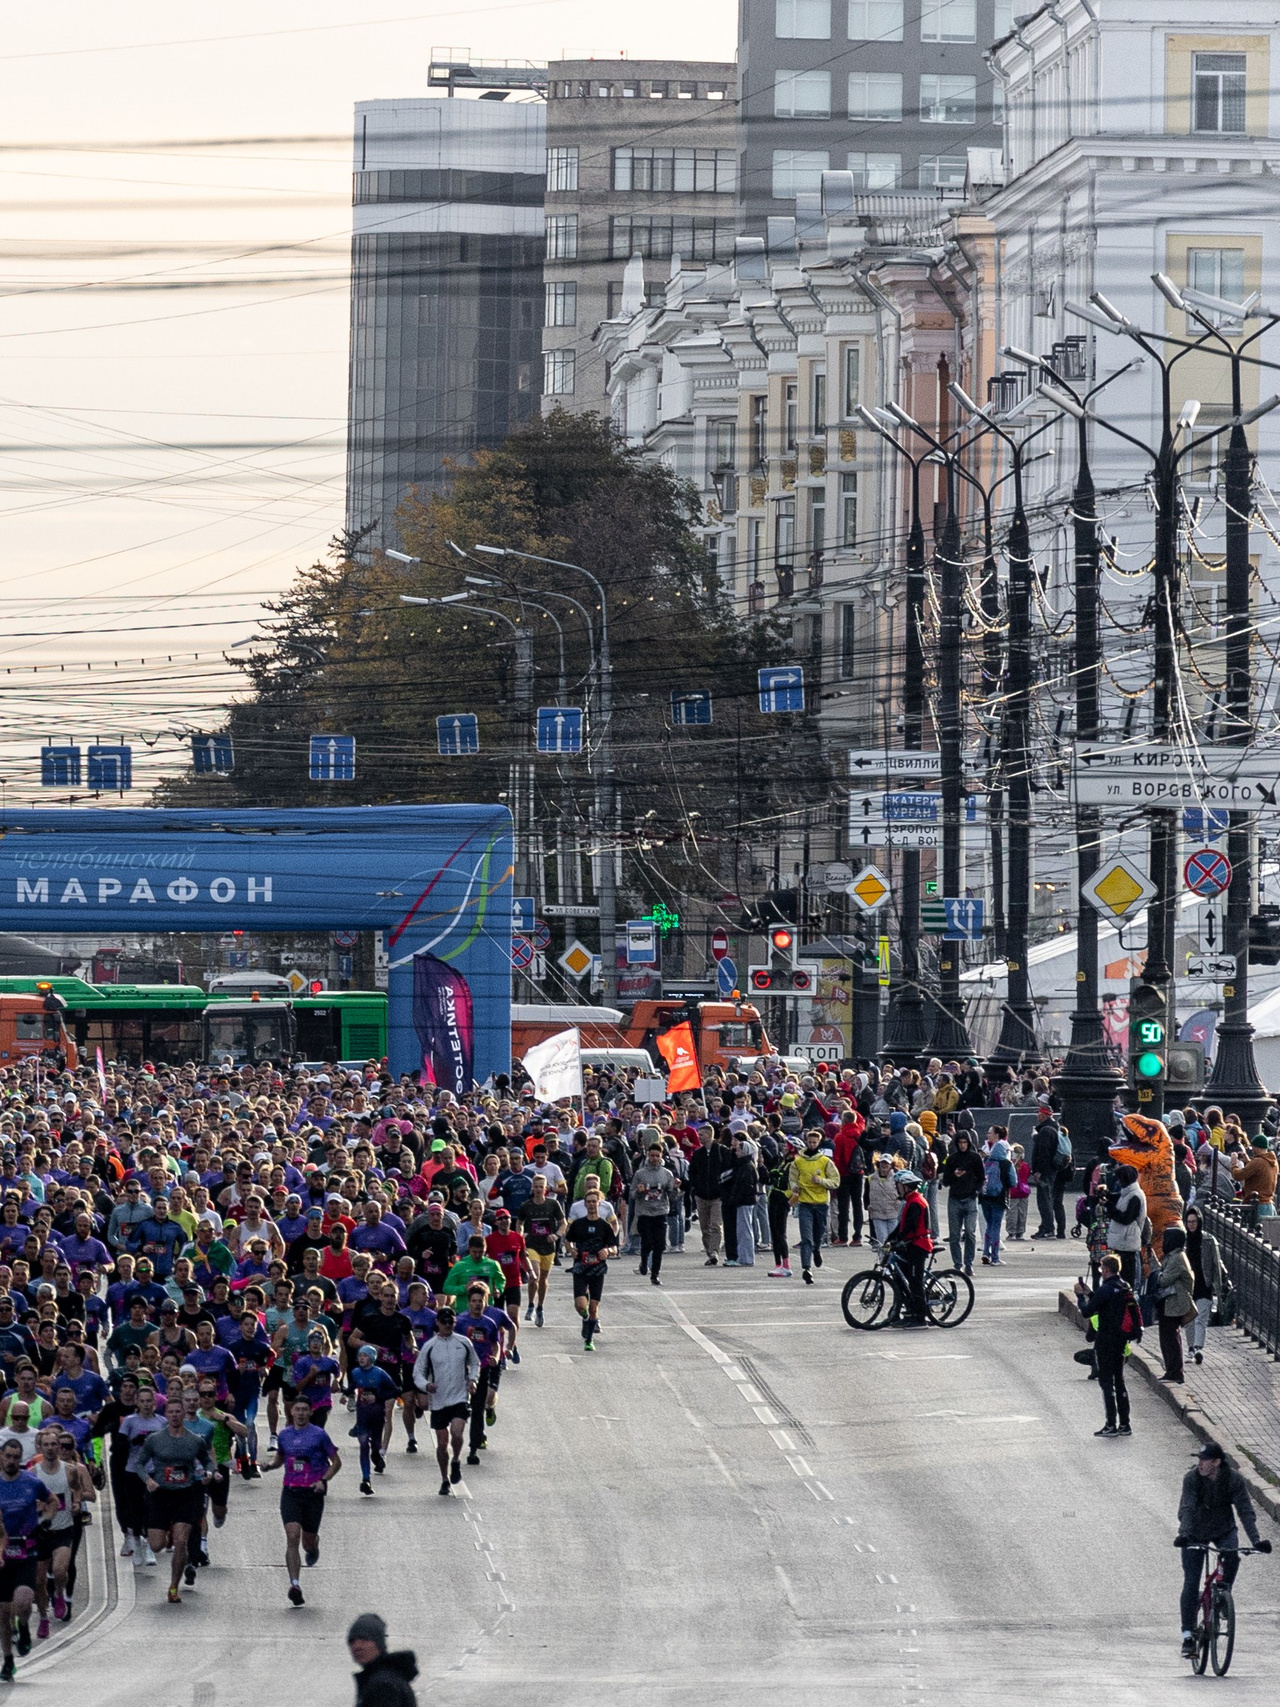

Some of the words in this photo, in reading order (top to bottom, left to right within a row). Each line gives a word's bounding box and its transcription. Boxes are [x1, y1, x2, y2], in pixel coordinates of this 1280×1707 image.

[889, 759, 939, 770] ЦВИЛЛИ
[1133, 752, 1208, 768] КИРОВА
[1132, 782, 1252, 800] ВОРОВСКОГО
[16, 876, 273, 905] МАРАФОН
[1141, 1023, 1162, 1043] 50
[793, 1046, 839, 1060] СТОП
